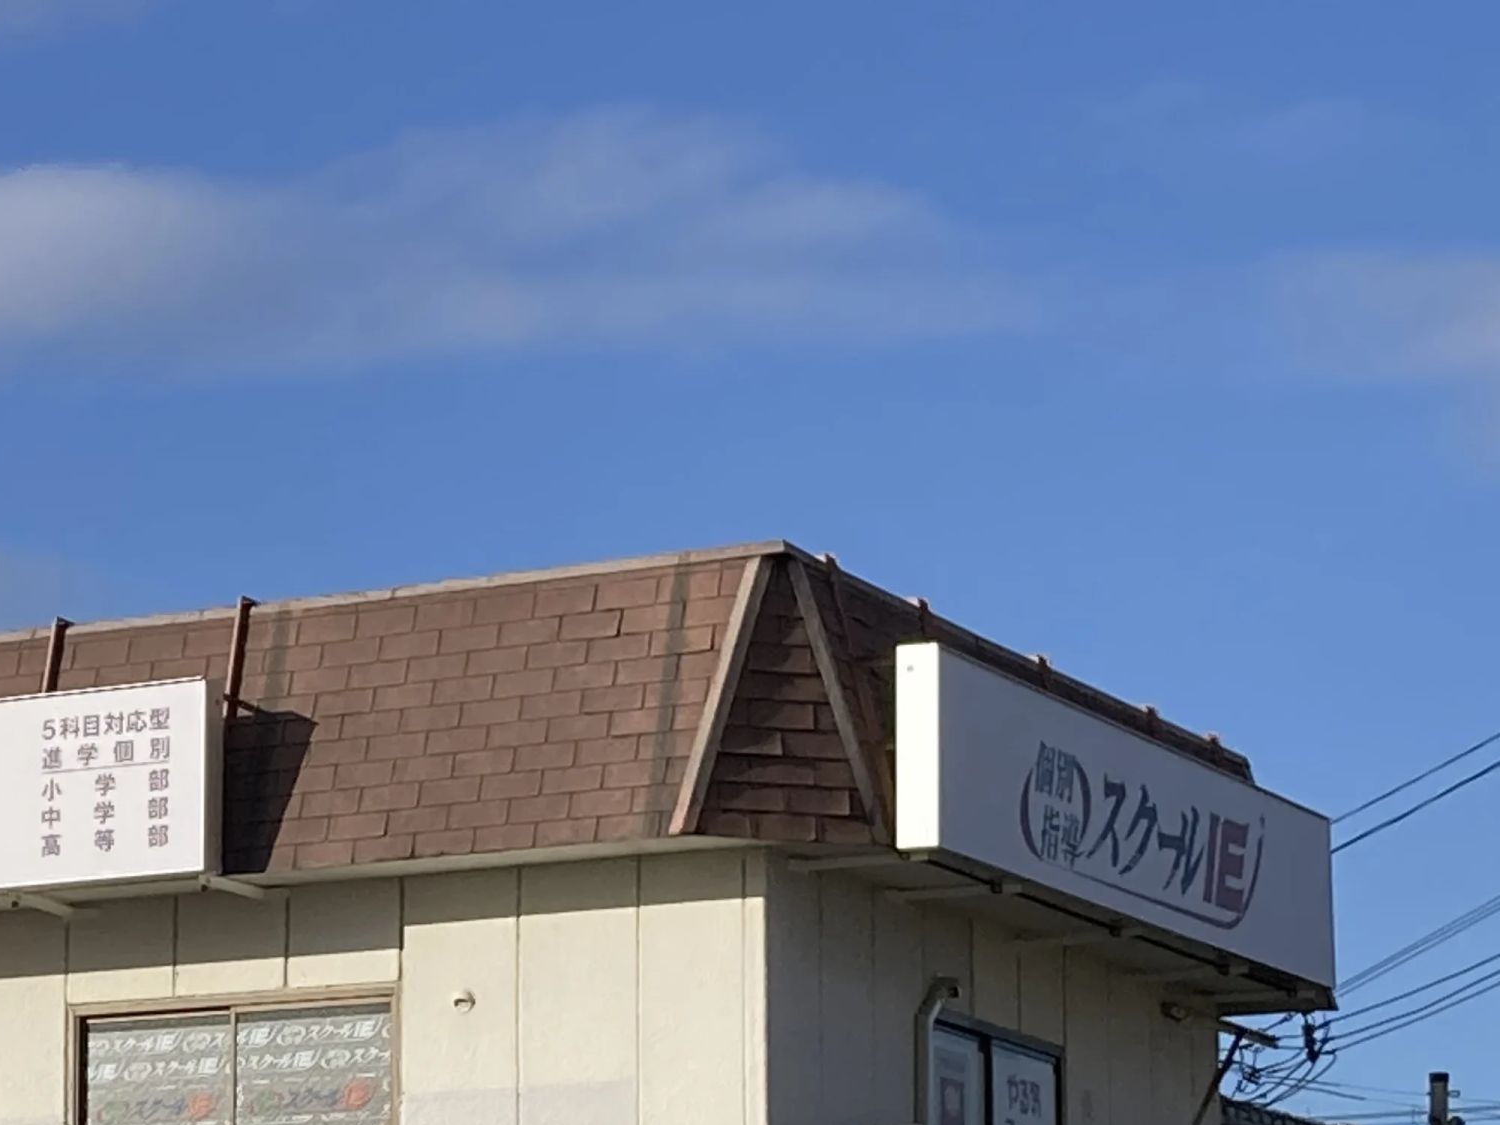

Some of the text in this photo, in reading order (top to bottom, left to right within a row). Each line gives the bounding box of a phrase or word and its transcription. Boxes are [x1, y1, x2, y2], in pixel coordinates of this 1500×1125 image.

[41, 706, 170, 741] 5科目対応型
[41, 736, 170, 770] 進学個別
[41, 769, 169, 801] 小学部
[1034, 739, 1075, 803] 個別
[41, 798, 169, 828] 中学部
[41, 825, 169, 857] 高等部
[1040, 805, 1086, 868] 指導
